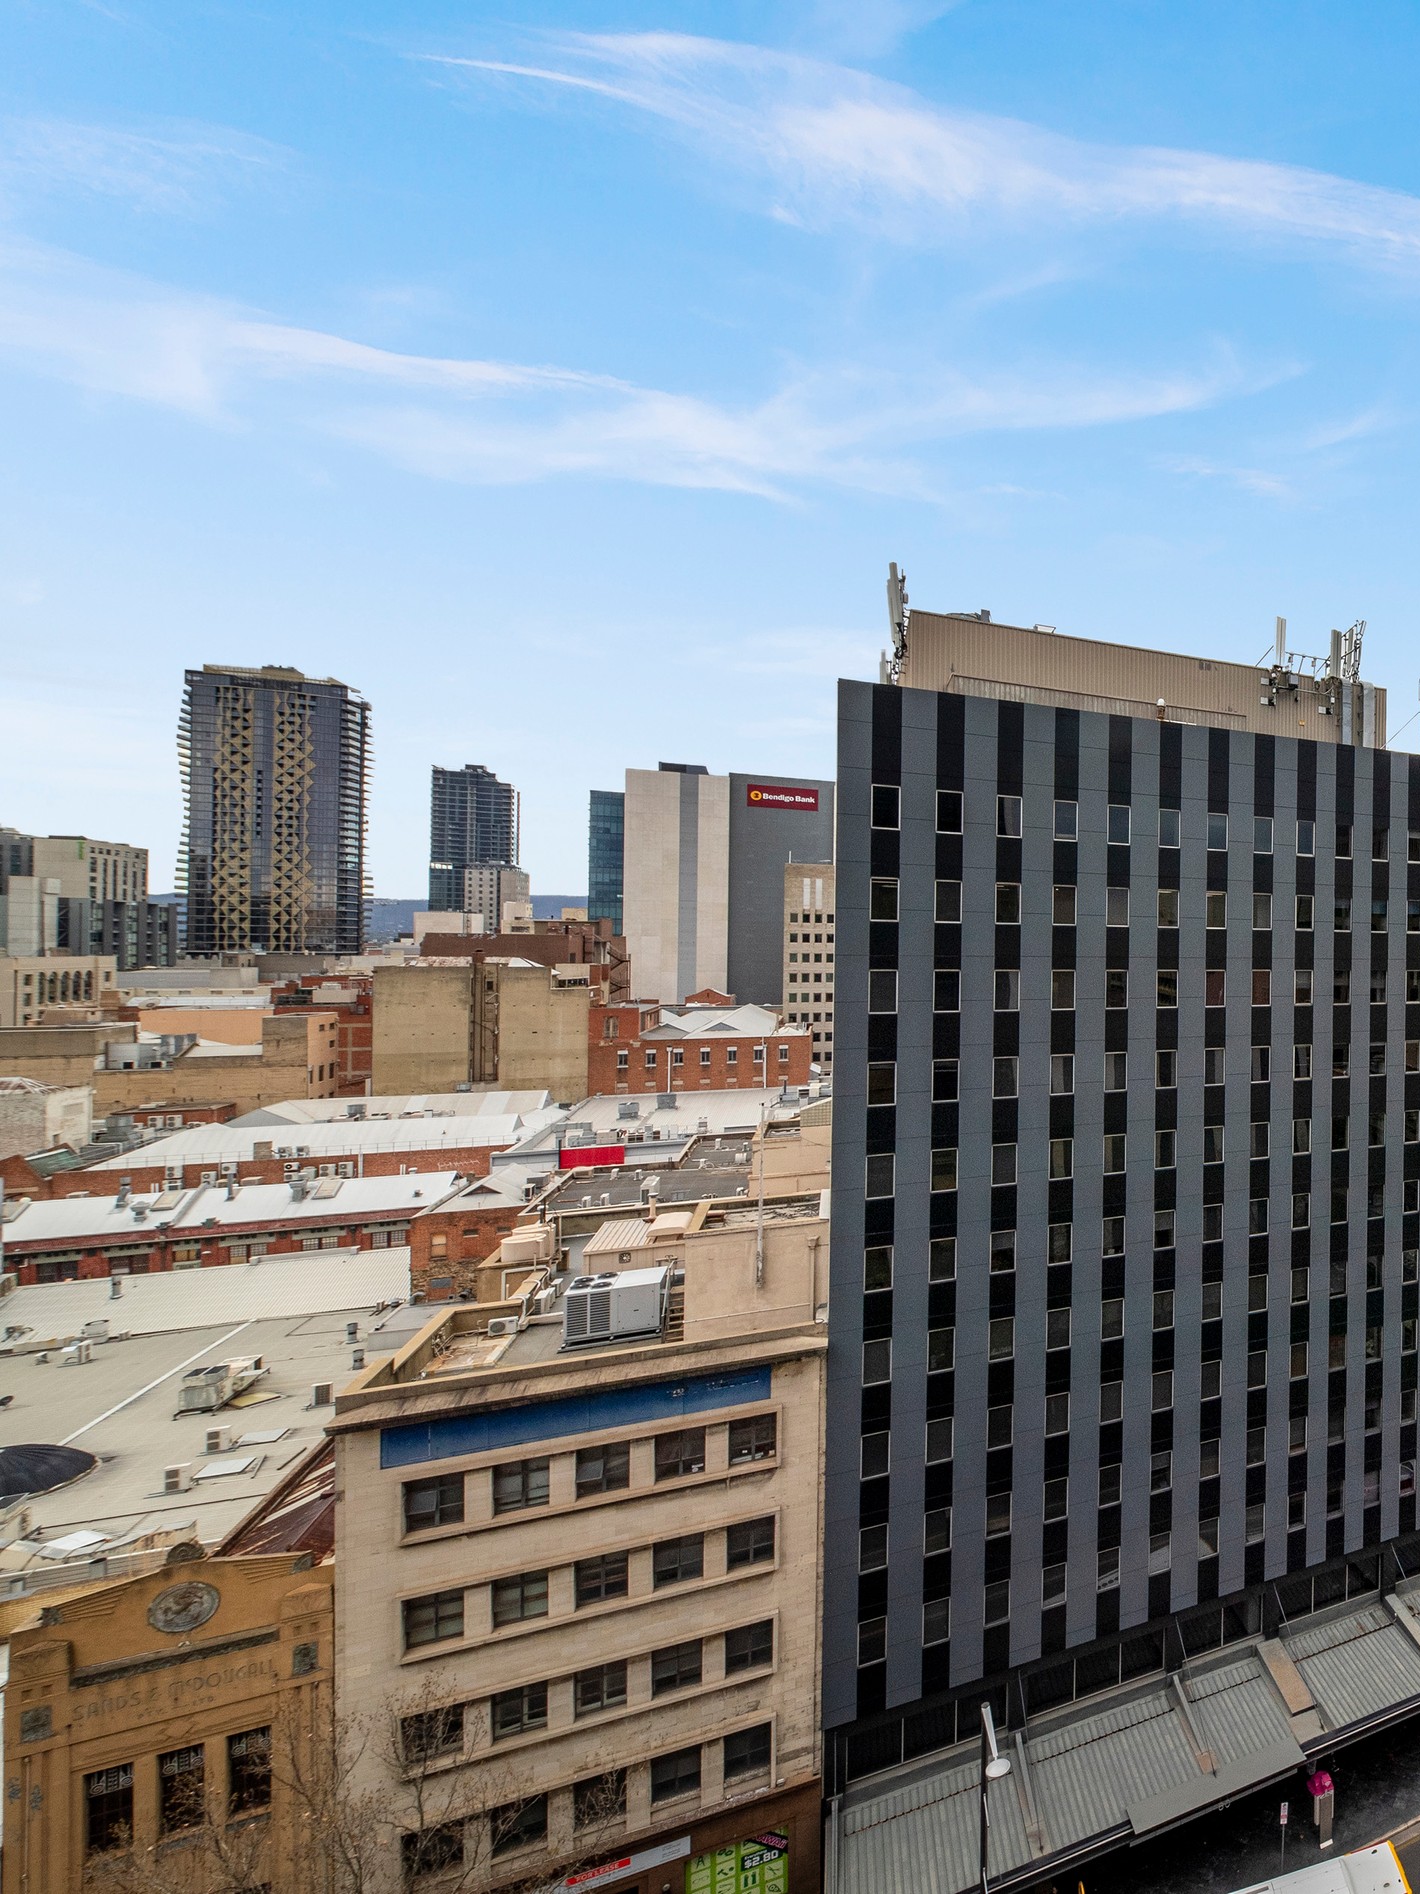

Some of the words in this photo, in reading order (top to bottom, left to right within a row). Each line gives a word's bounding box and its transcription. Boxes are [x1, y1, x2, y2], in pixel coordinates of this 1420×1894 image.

[763, 793, 794, 802] Bendigo
[72, 1690, 142, 1722] SANDS
[744, 1849, 779, 1869] $2.80
[576, 1871, 593, 1883] FOR
[594, 1862, 620, 1877] LEASE
